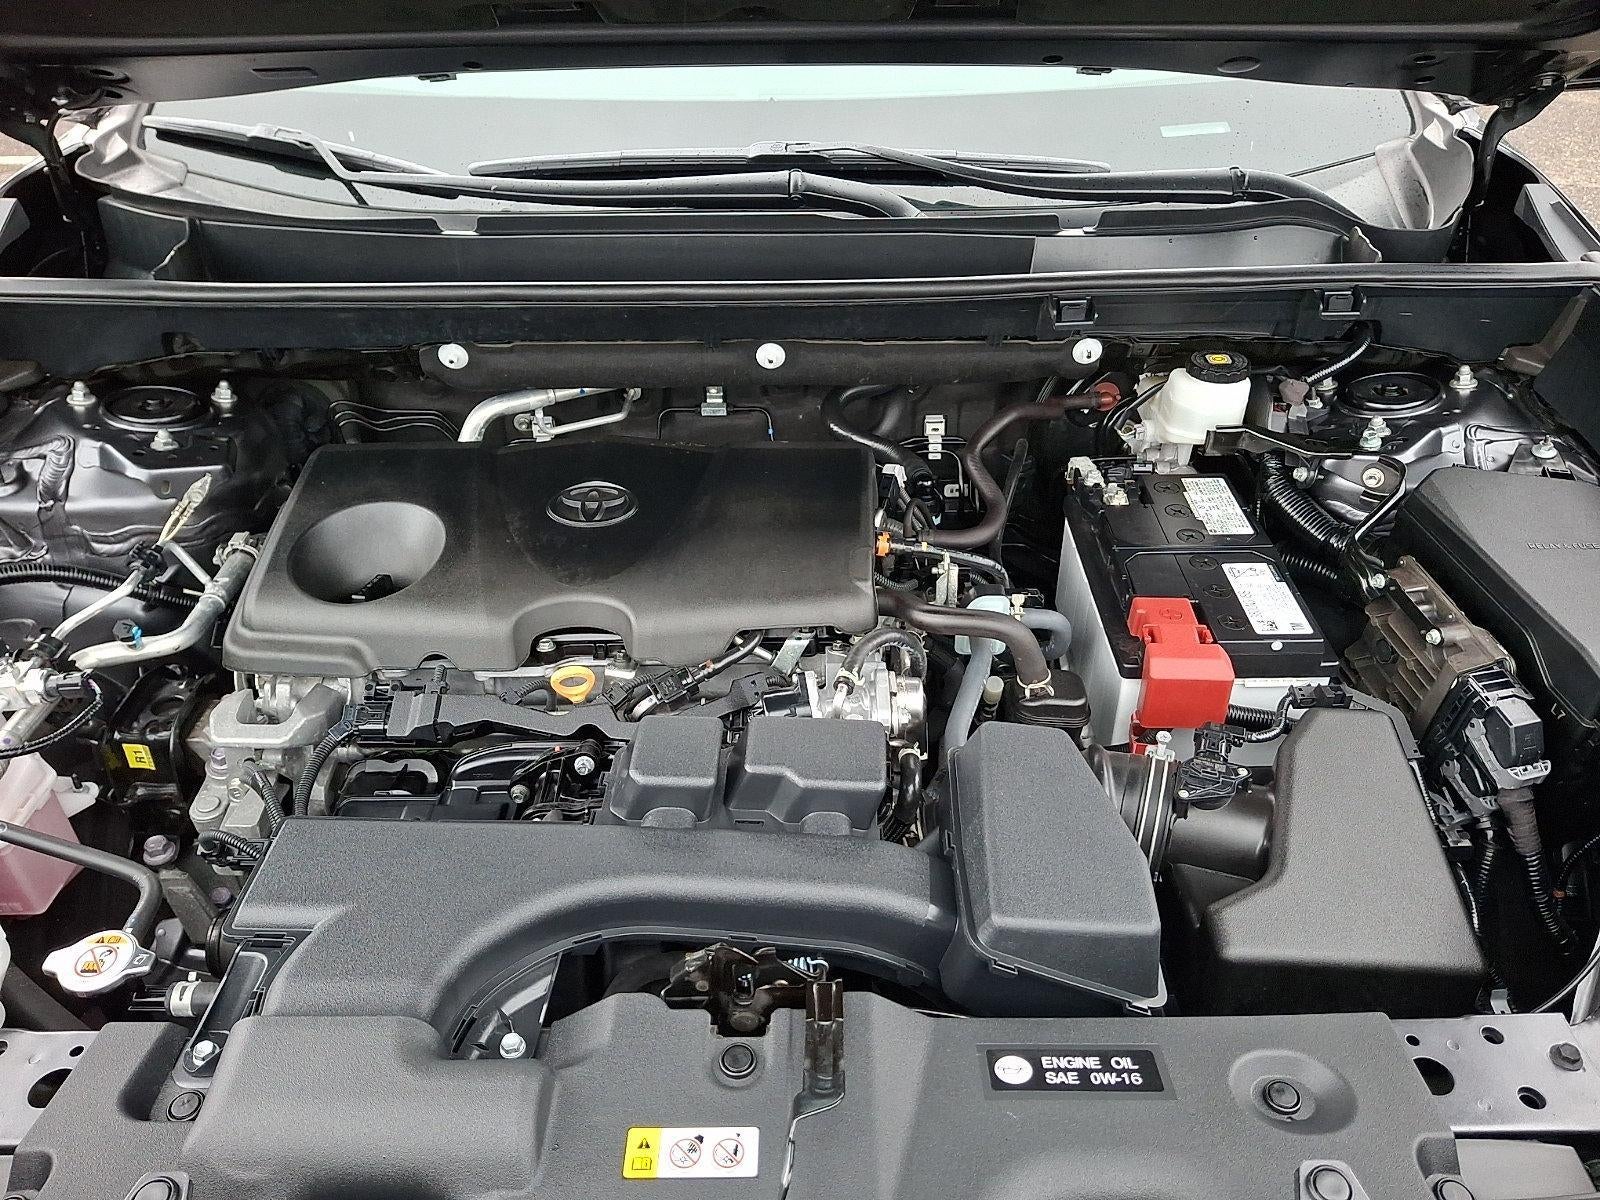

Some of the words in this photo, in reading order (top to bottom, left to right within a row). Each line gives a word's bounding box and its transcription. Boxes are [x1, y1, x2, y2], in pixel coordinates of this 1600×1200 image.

[1526, 542, 1560, 550] RELAY
[1040, 1056, 1102, 1069] ENGINE
[1110, 1056, 1140, 1070] OIL
[1045, 1071, 1081, 1084] SAE
[1090, 1072, 1144, 1085] 0W-16
